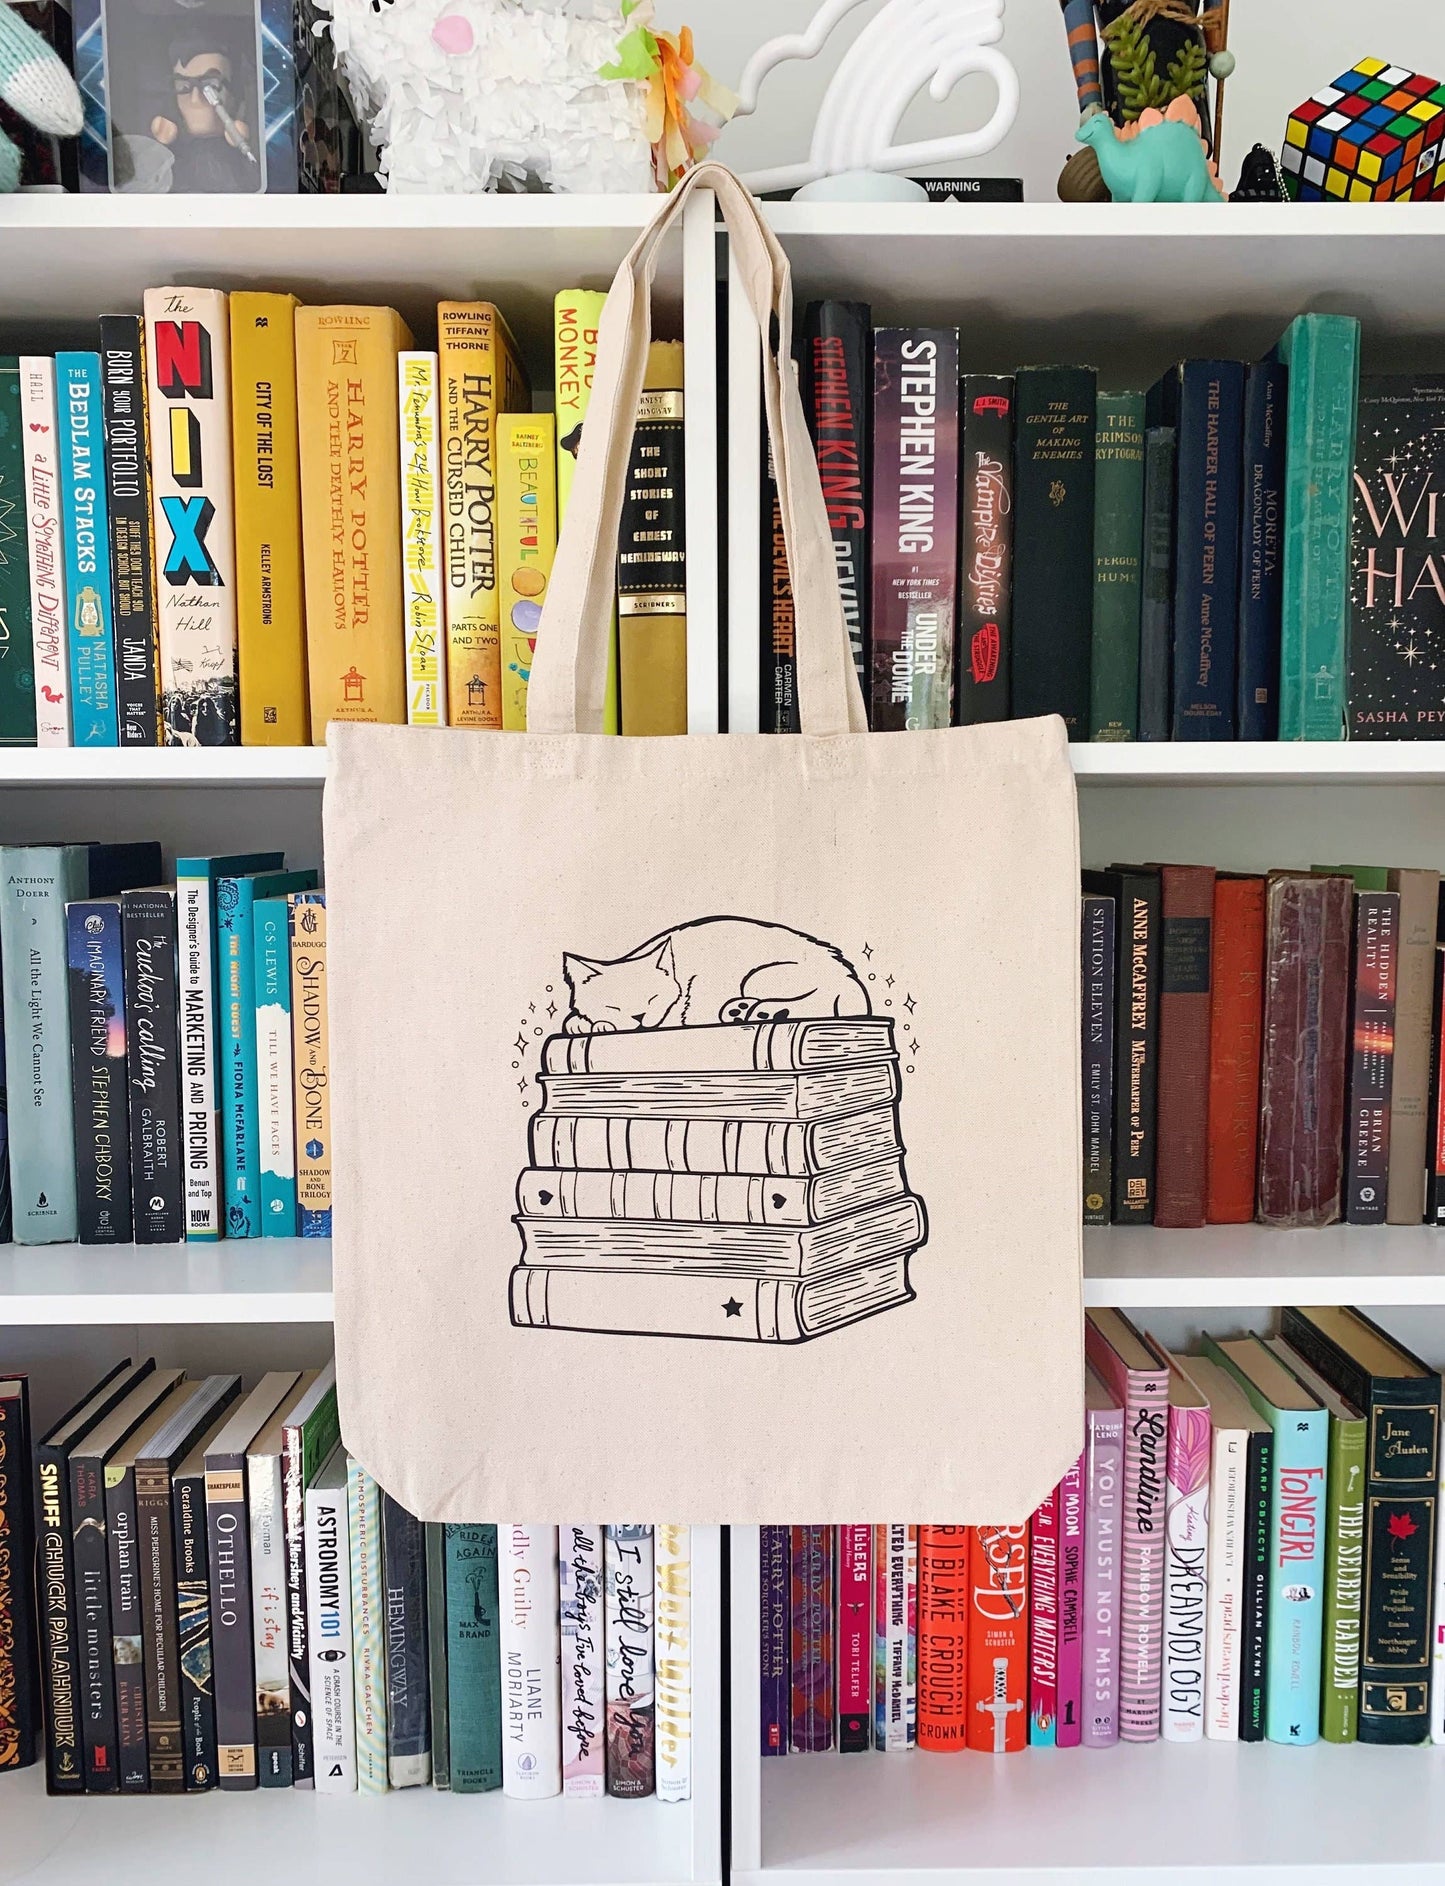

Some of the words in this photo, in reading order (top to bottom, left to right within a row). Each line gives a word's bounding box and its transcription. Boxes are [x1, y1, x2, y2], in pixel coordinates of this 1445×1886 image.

[925, 181, 981, 193] WARNING
[164, 295, 194, 313] the
[318, 316, 370, 325] ROWLING
[443, 312, 491, 321] ROWLING
[445, 327, 489, 336] TIFFANY
[446, 342, 489, 351] THORNE
[106, 351, 134, 384] BURN
[558, 309, 580, 410] MONKEY
[256, 382, 272, 409] CITY
[448, 378, 457, 404] AND
[813, 337, 854, 430] STEPHEN
[1208, 380, 1220, 410] THE
[256, 413, 272, 428] OF
[449, 410, 459, 431] THE
[463, 373, 492, 477] HARRY
[900, 340, 937, 475] STEPHEN
[1026, 415, 1066, 424] GENTLE
[1069, 415, 1088, 423] ART
[1107, 416, 1135, 426] THE
[68, 382, 92, 481] BEDLAM
[257, 431, 273, 454] THE
[347, 379, 368, 500] HARRY
[640, 446, 660, 458] THE
[1036, 439, 1081, 447] MAKING
[1206, 414, 1219, 476] HARPER
[110, 419, 140, 497] PORTFOLIO
[154, 321, 226, 587] NIX
[258, 458, 273, 489] LOST
[634, 467, 668, 479] SHORT
[1033, 451, 1083, 459] ENEMIES
[447, 437, 464, 517] CURSED
[630, 488, 674, 500] STORIES
[817, 440, 865, 530] KING
[518, 458, 539, 561] BEAUTIFUL
[645, 510, 659, 520] OF
[899, 484, 935, 553] KING
[1204, 481, 1217, 518] HALL
[1252, 464, 1263, 547] DRAGONLADY
[74, 487, 96, 573] STACKS
[464, 483, 496, 599] POTTER
[633, 531, 673, 542] ERNEST
[1203, 526, 1216, 541] OF
[261, 543, 271, 574] KELLEY
[351, 511, 370, 629] POTTER
[450, 523, 466, 588] CHILD
[620, 552, 685, 564] HEMINGWAY
[1202, 546, 1215, 585] PERN
[1253, 550, 1261, 566] OF
[166, 594, 220, 608] Nathan
[261, 576, 272, 625] ARMSTRONG
[412, 592, 432, 628] Robin
[634, 601, 675, 609] SCRIBNERS
[175, 616, 212, 631] Hill
[475, 637, 498, 645] TWO
[900, 630, 913, 651] THE
[915, 613, 937, 675] UNDER
[123, 638, 146, 681] JANDA
[415, 631, 435, 671] Sloan
[78, 647, 92, 705] PULLEY
[94, 641, 109, 710] NATASHA
[775, 667, 783, 704] CARTER
[784, 665, 792, 706] CARMEN
[891, 651, 913, 704] DOME
[1357, 712, 1408, 723] SASHA
[8, 875, 54, 884] ANTHONY
[16, 889, 50, 898] DOERR
[188, 890, 198, 904] The
[186, 908, 199, 949] Designer's
[1133, 898, 1148, 940] ANNE
[1366, 909, 1378, 968] REALITY
[1381, 908, 1391, 936] THE
[30, 949, 41, 965] All
[1092, 908, 1104, 976] STATION
[30, 967, 41, 986] the
[86, 941, 105, 1005] IMAGINARY
[190, 952, 200, 975] Guide
[265, 950, 277, 995] LEWIS
[1379, 944, 1390, 1000] HIDDEN
[29, 990, 42, 1020] Light
[296, 956, 324, 1049] SHADOW
[1132, 944, 1147, 1030] McCAFFREY
[31, 1022, 43, 1040] We
[89, 1009, 106, 1056] FRIEND
[185, 990, 206, 1076] MARKETING
[1091, 982, 1102, 1044] ELEVEN
[33, 1044, 43, 1086] Cannot
[132, 1018, 166, 1094] calling
[1091, 1063, 1100, 1090] EMILY
[1131, 1040, 1146, 1114] MASTERHARPER
[34, 1088, 44, 1107] See
[92, 1065, 111, 1129] STEPHEN
[190, 1082, 204, 1104] AND
[234, 1062, 243, 1098] FIONA
[300, 1066, 327, 1130] BONE
[189, 1112, 208, 1170] PRICING
[235, 1104, 245, 1171] McFARLANE
[1091, 1111, 1100, 1134] JOHN
[1131, 1116, 1139, 1127] OF
[1358, 1109, 1369, 1167] GREENE
[1372, 1110, 1382, 1152] BRIAN
[141, 1108, 154, 1181] GALBRAITH
[156, 1120, 167, 1168] ROBERT
[1091, 1137, 1100, 1173] MANDEL
[1131, 1130, 1144, 1157] PERN
[94, 1134, 113, 1201] CHBOSKY
[201, 1190, 212, 1198] Top
[191, 1210, 210, 1221] HOW
[1382, 1421, 1411, 1441] Jane
[1385, 1441, 1428, 1458] Austen
[1099, 1459, 1114, 1508] YOU
[1133, 1409, 1165, 1534] Landline
[1260, 1448, 1268, 1492] SHARP
[40, 1463, 61, 1527] SNUFF
[181, 1486, 192, 1534] Geraldine
[1065, 1494, 1080, 1536] MOON
[112, 1512, 134, 1568] orphan
[1258, 1501, 1266, 1562] OBJECTS
[1339, 1503, 1363, 1539] THE
[184, 1539, 194, 1573] Brooks
[216, 1513, 238, 1626] OTHELLO
[1097, 1519, 1113, 1580] MUST
[44, 1532, 67, 1611] CHUCK
[119, 1574, 136, 1611] train
[316, 1506, 341, 1638] ASTRONOMY101
[931, 1558, 955, 1622] BLAKE
[1138, 1547, 1151, 1617] RAINBOW
[1336, 1545, 1363, 1613] SECRET
[84, 1571, 102, 1621] little
[511, 1568, 531, 1630] Guilty
[1097, 1591, 1111, 1637] NOT
[1255, 1575, 1264, 1628] GILLIAN
[388, 1587, 408, 1709] HEMINGWAY
[459, 1630, 491, 1639] BRAND
[851, 1633, 860, 1658] TORI
[1168, 1547, 1205, 1716] DREAMOLOGY
[87, 1629, 102, 1720] monsters
[1096, 1648, 1110, 1701] MISS
[1137, 1624, 1150, 1684] ROWELL
[1254, 1636, 1262, 1677] FLYNN
[1333, 1619, 1360, 1688] GARDEN
[48, 1617, 75, 1747] PALAHNIUK
[507, 1651, 524, 1743] MORIARTY
[526, 1668, 542, 1720] LIANE
[851, 1663, 860, 1697] TELFER
[930, 1636, 955, 1716] CROUCH
[920, 1727, 957, 1739] CROWN
